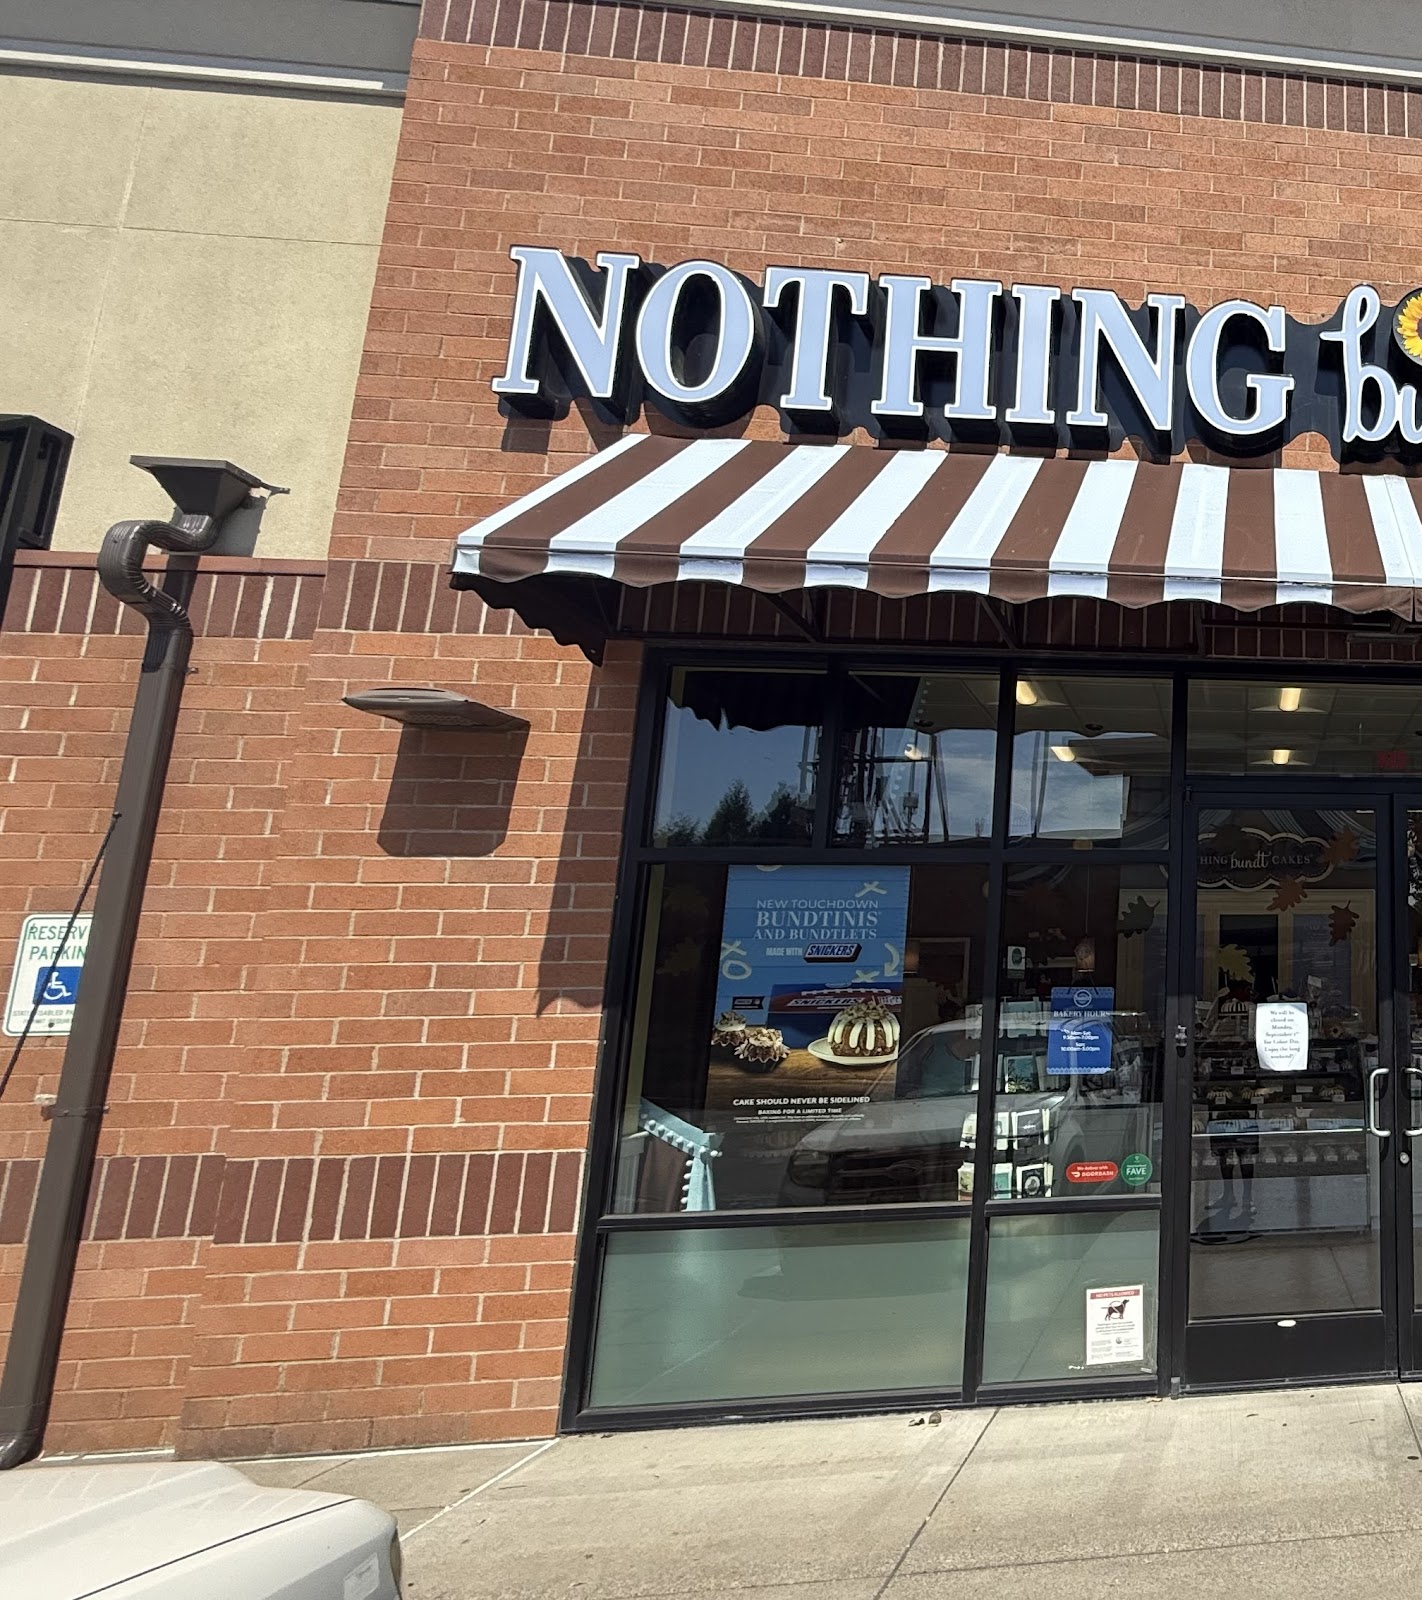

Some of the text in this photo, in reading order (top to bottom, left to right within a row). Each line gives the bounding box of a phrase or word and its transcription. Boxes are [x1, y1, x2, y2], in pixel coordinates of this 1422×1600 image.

[491, 244, 1294, 435] NOTHING
[1229, 850, 1272, 868] bundt
[1272, 855, 1311, 865] CAKES
[756, 899, 878, 909] NEW TOUCHDOWN
[756, 911, 878, 927] BUNDTINIS
[753, 928, 877, 940] AND BUNDTLETS
[765, 945, 855, 956] MADE WITH SNICKERS
[790, 1097, 817, 1105] NEVER
[829, 1096, 871, 1104] SIDELINED
[1126, 1167, 1147, 1176] FAVE
